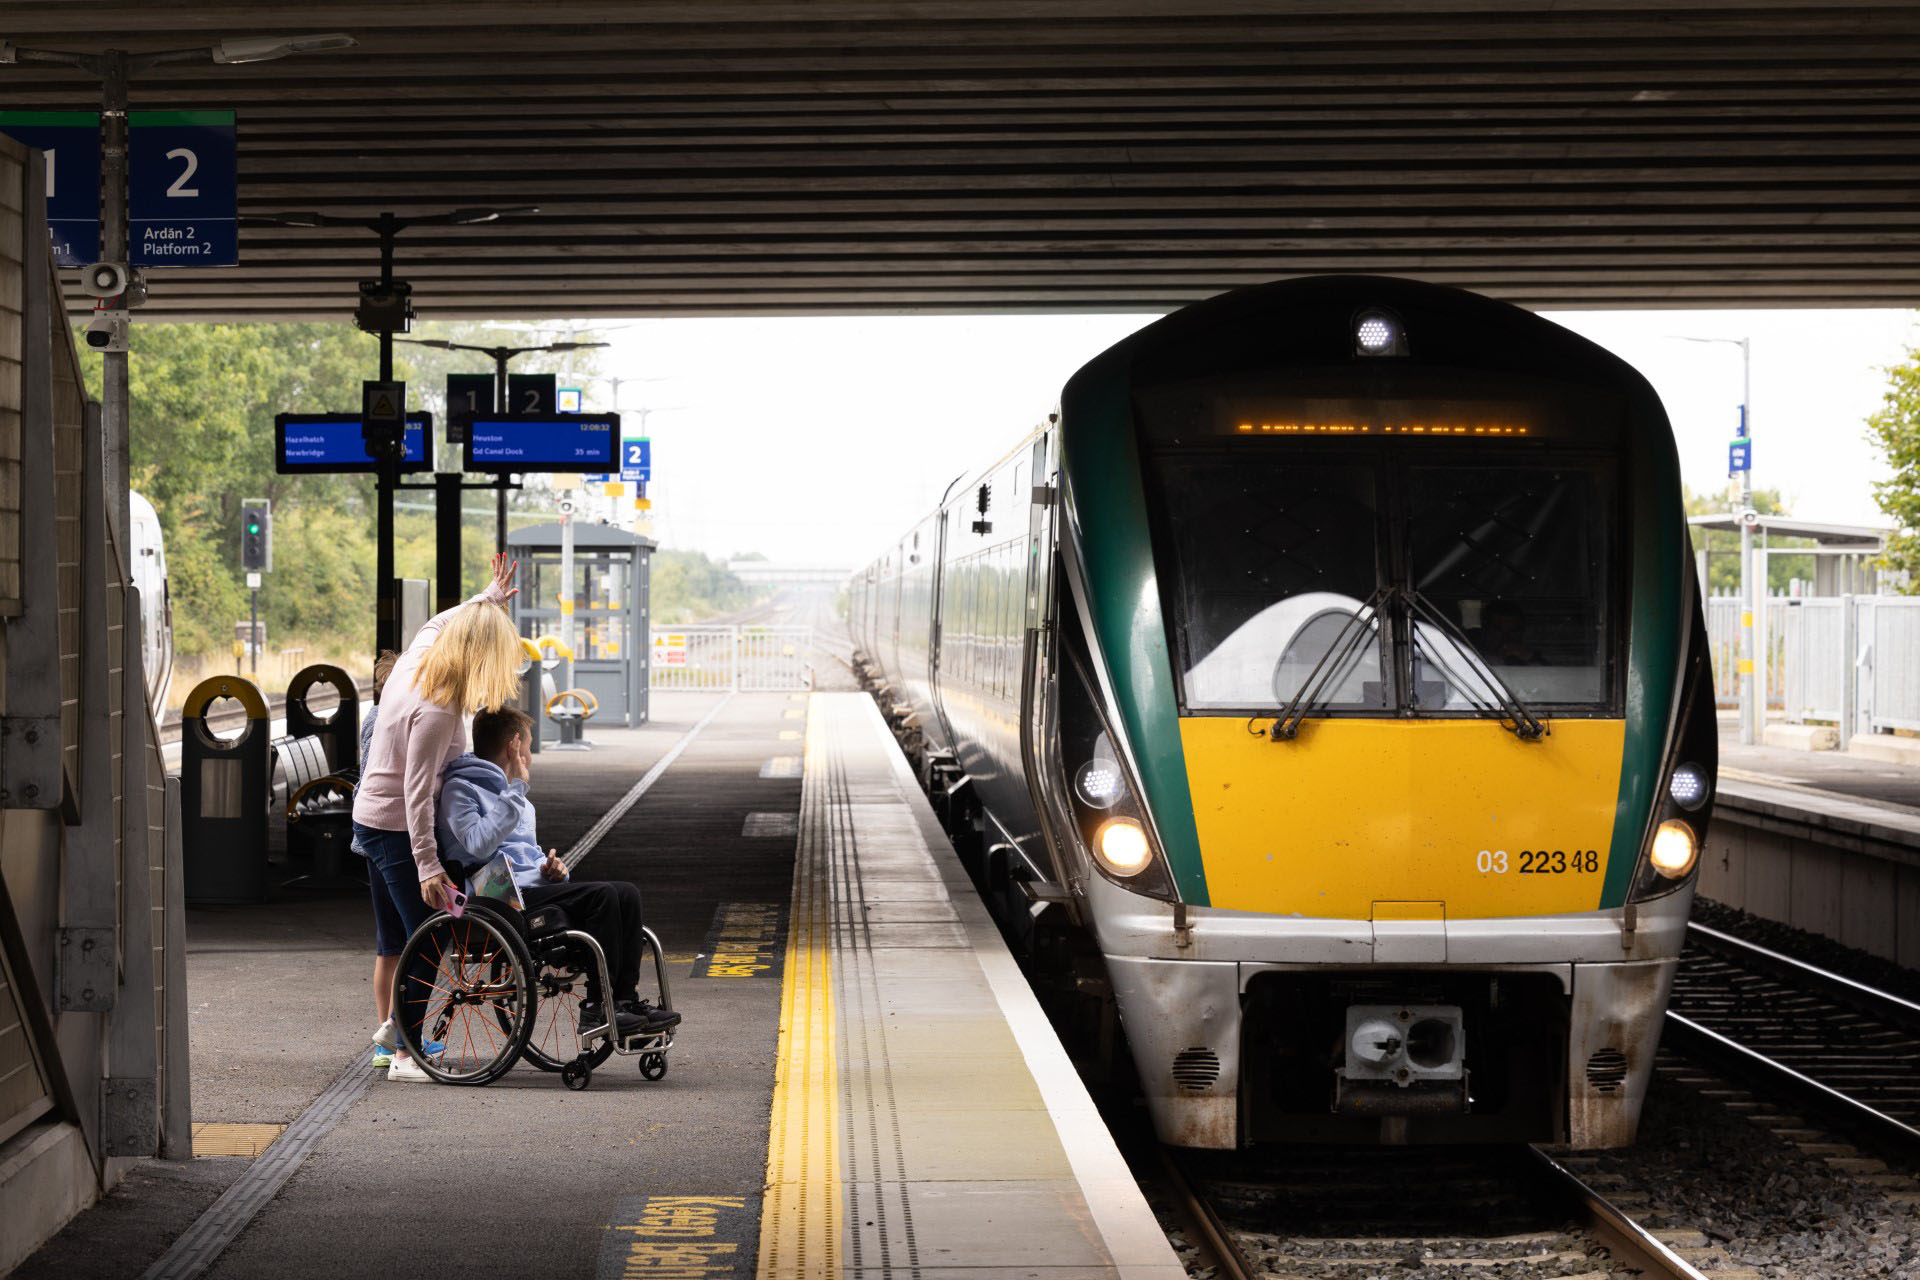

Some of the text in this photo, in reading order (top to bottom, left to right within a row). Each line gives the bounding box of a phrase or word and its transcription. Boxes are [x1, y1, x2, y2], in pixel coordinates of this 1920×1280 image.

[43, 148, 56, 198] 1
[166, 148, 199, 197] 2
[143, 226, 195, 240] Ardán 2
[64, 242, 71, 255] 1
[143, 242, 212, 256] Platform 2
[466, 390, 477, 412] 1
[523, 389, 541, 414] 2
[285, 448, 326, 458] Newbridge
[629, 445, 642, 464] 2
[1476, 849, 1599, 874] 03 22348
[615, 1196, 746, 1280] Keep Beh
